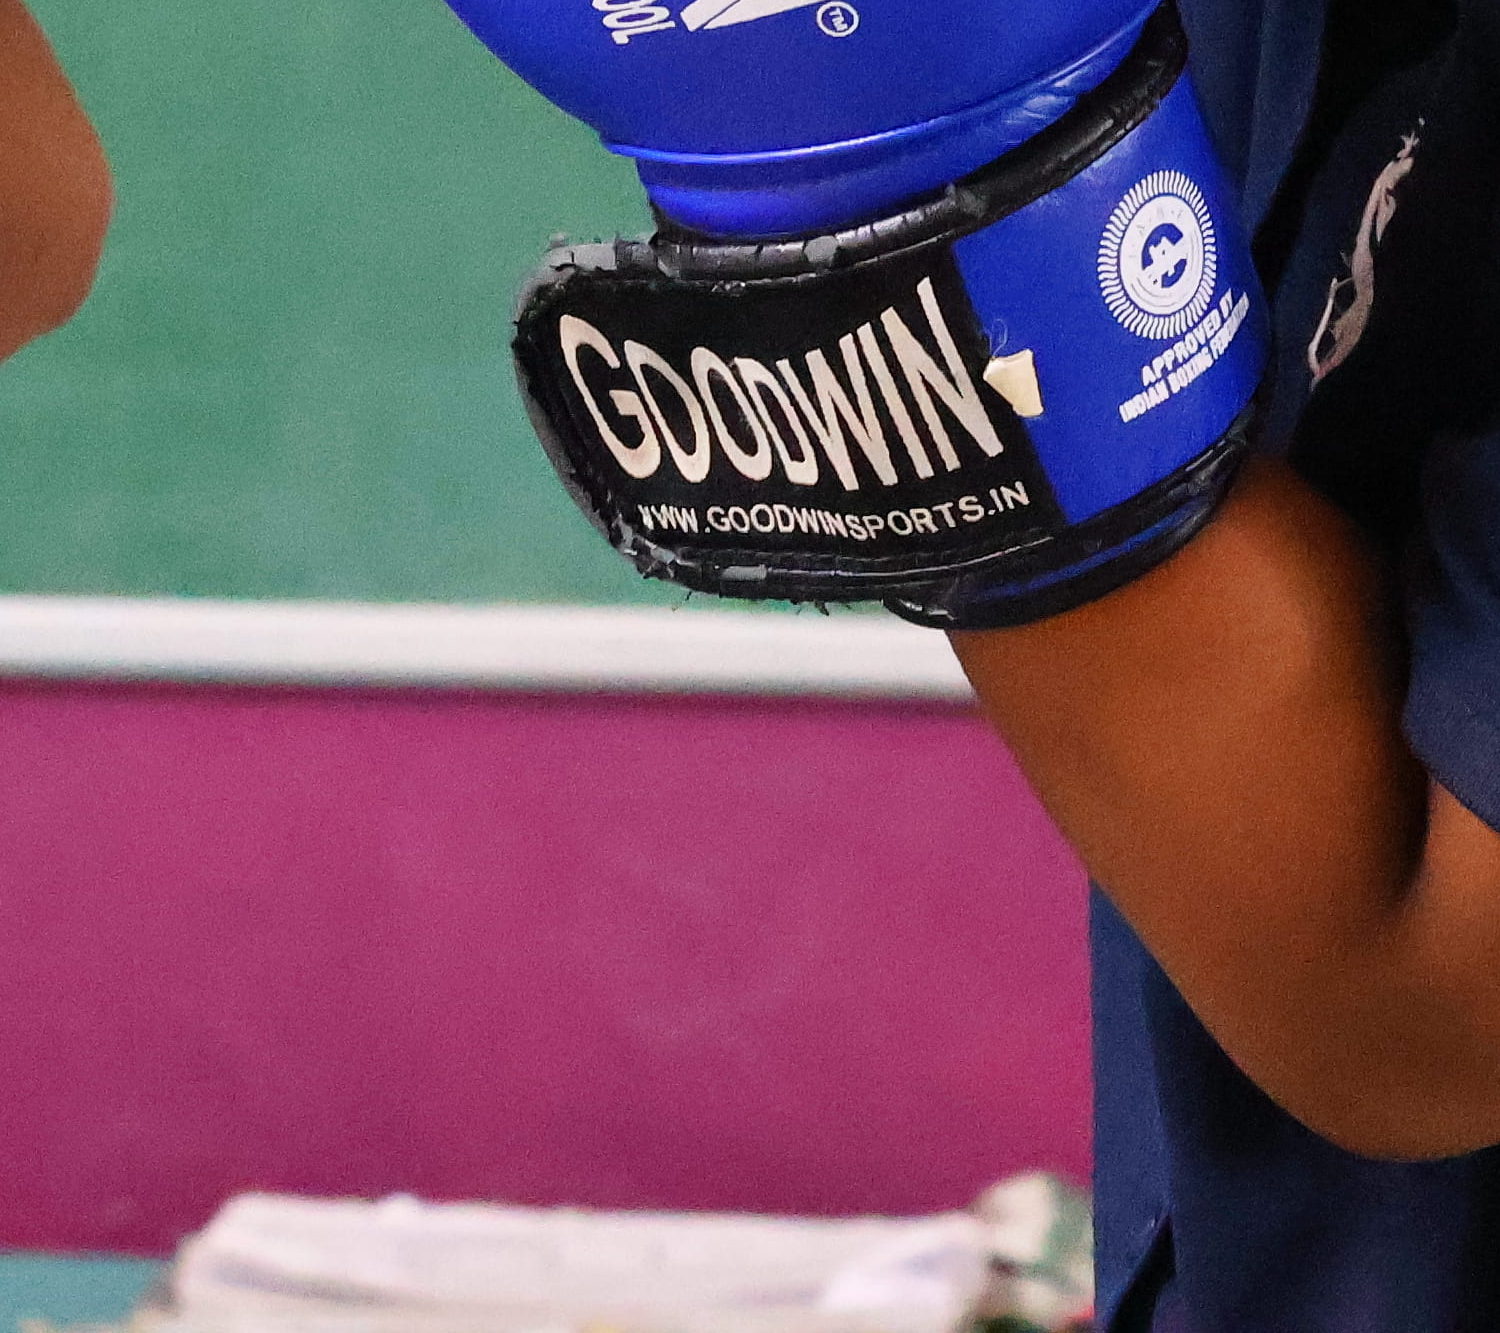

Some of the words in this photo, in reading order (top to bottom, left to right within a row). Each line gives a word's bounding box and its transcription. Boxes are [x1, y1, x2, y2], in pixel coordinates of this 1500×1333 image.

[559, 276, 1004, 492] GOODWIN
[1142, 309, 1222, 387] APPROVED
[638, 480, 1031, 542] WWW.GOODWINSPORTS.IN
